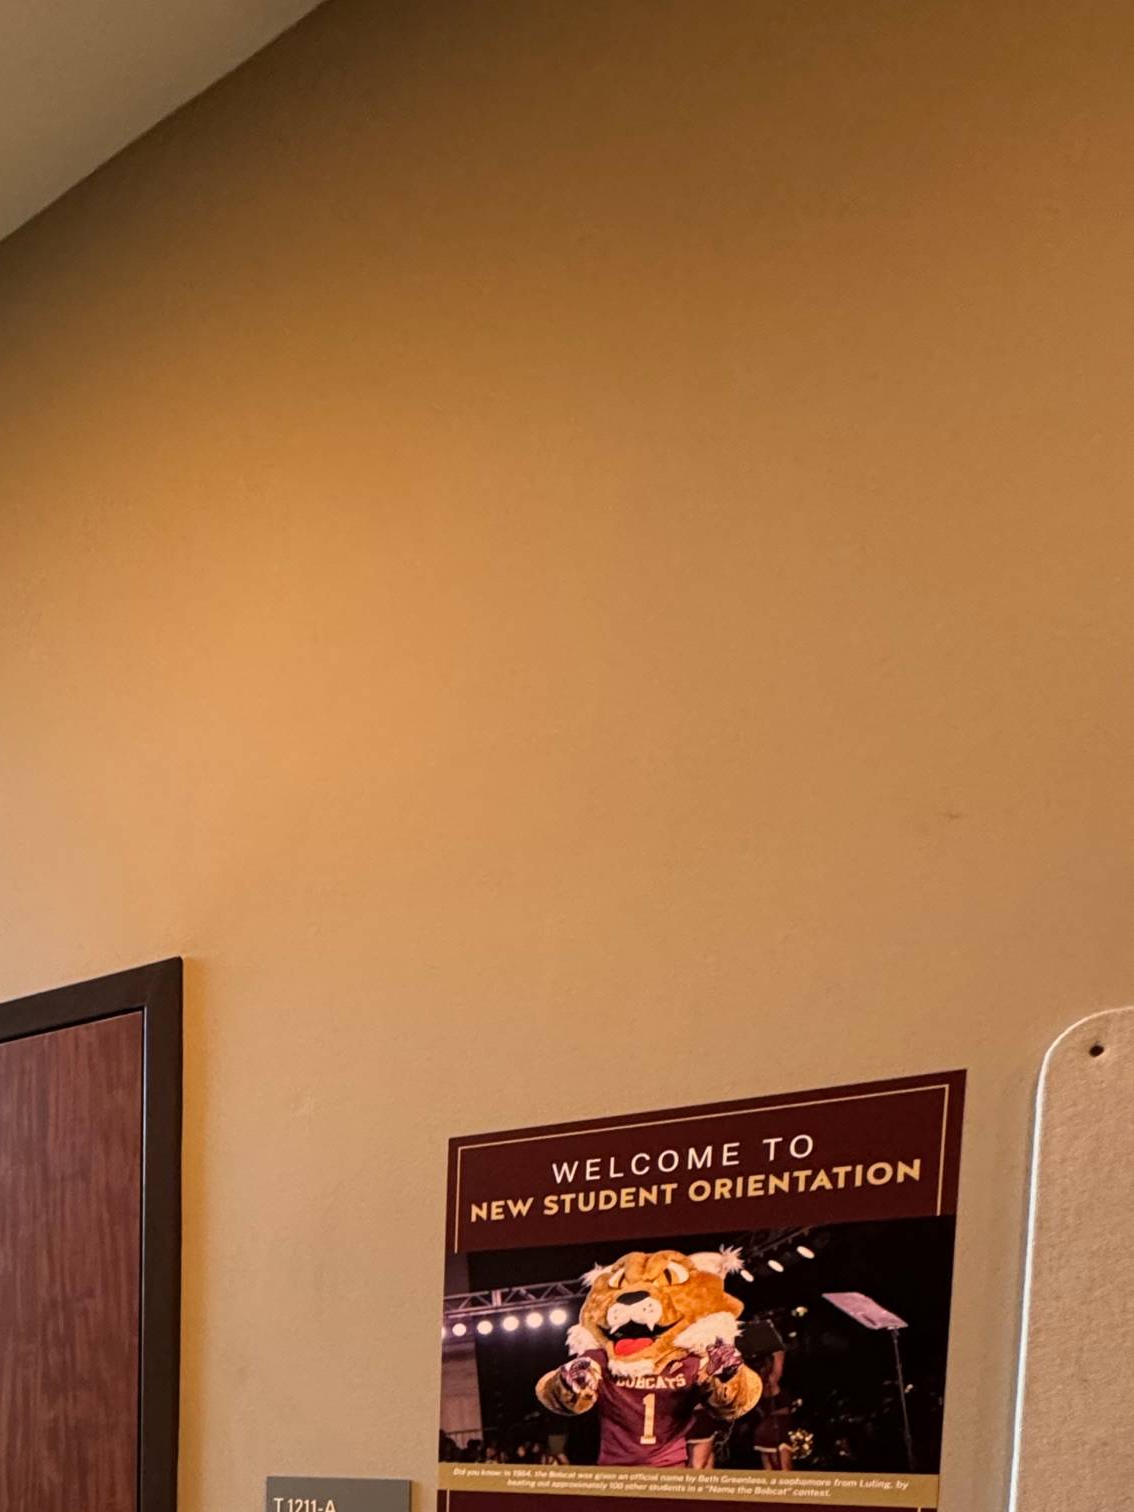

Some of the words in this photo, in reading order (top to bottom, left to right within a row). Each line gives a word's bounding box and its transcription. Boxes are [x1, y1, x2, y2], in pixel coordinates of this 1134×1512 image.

[552, 1142, 740, 1184] WELCOME
[762, 1134, 814, 1161] TO
[470, 1197, 534, 1222] NEW
[543, 1183, 678, 1215] STUDENT
[688, 1158, 921, 1202] ORIENTATION
[640, 1393, 656, 1445] 1
[625, 1482, 648, 1490] other
[649, 1483, 686, 1492] students
[737, 1486, 753, 1494] the
[660, 1474, 684, 1482] name
[685, 1474, 696, 1484] by
[778, 1477, 832, 1488] sophomore
[833, 1478, 858, 1487] from
[895, 1479, 909, 1490] by
